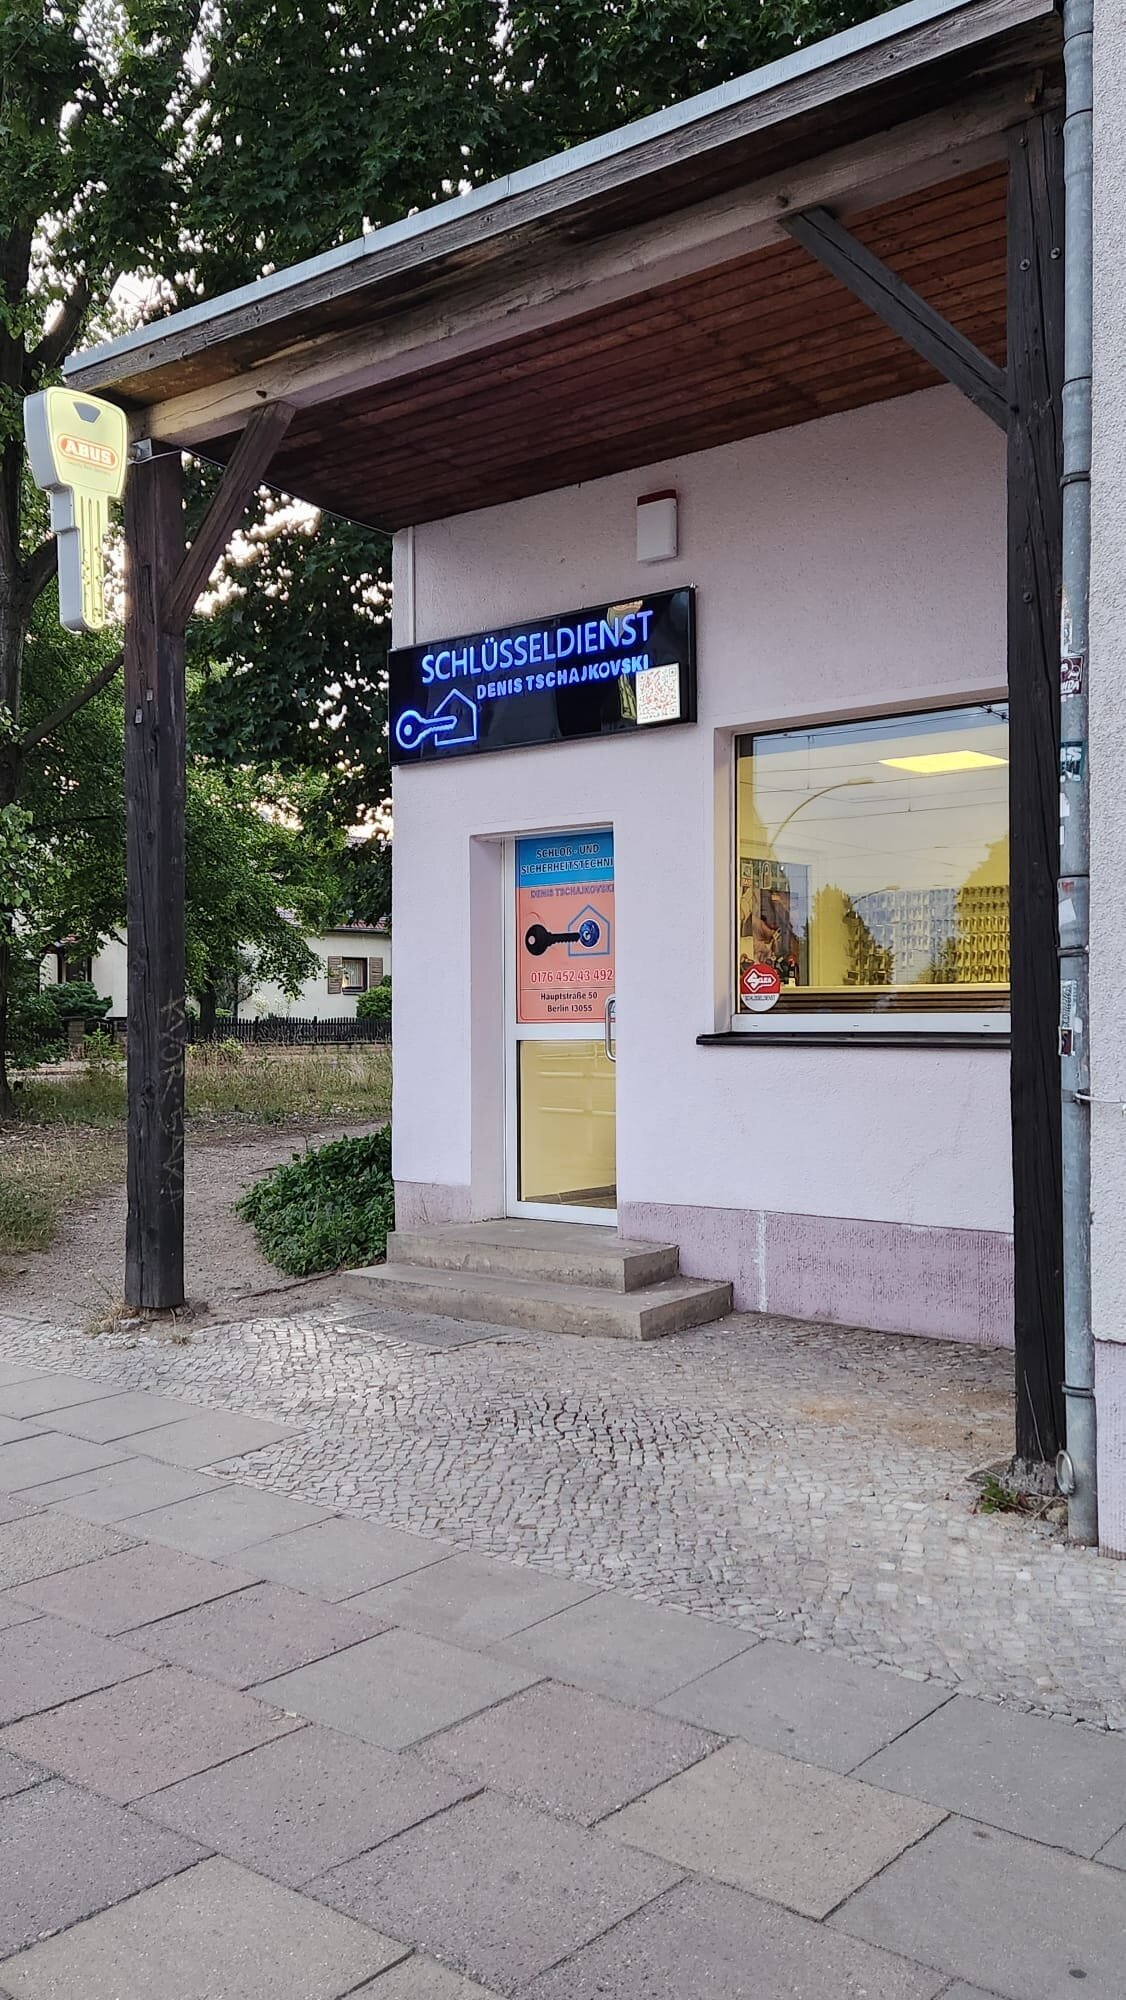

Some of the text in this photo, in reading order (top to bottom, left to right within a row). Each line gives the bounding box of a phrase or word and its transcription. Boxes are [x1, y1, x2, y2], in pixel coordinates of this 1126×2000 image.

[64, 439, 112, 466] ABUS
[421, 609, 653, 684] SCHLÜSSELDIENST
[476, 654, 649, 700] DENIS TSCHAJKOVSKI
[579, 843, 600, 855] UND
[521, 857, 614, 875] SICHERHEITSTECHNI
[531, 968, 613, 983] 0176 452 43 492
[540, 991, 598, 1002] Hauptstraße 50
[547, 1004, 593, 1012] Berlin 13055
